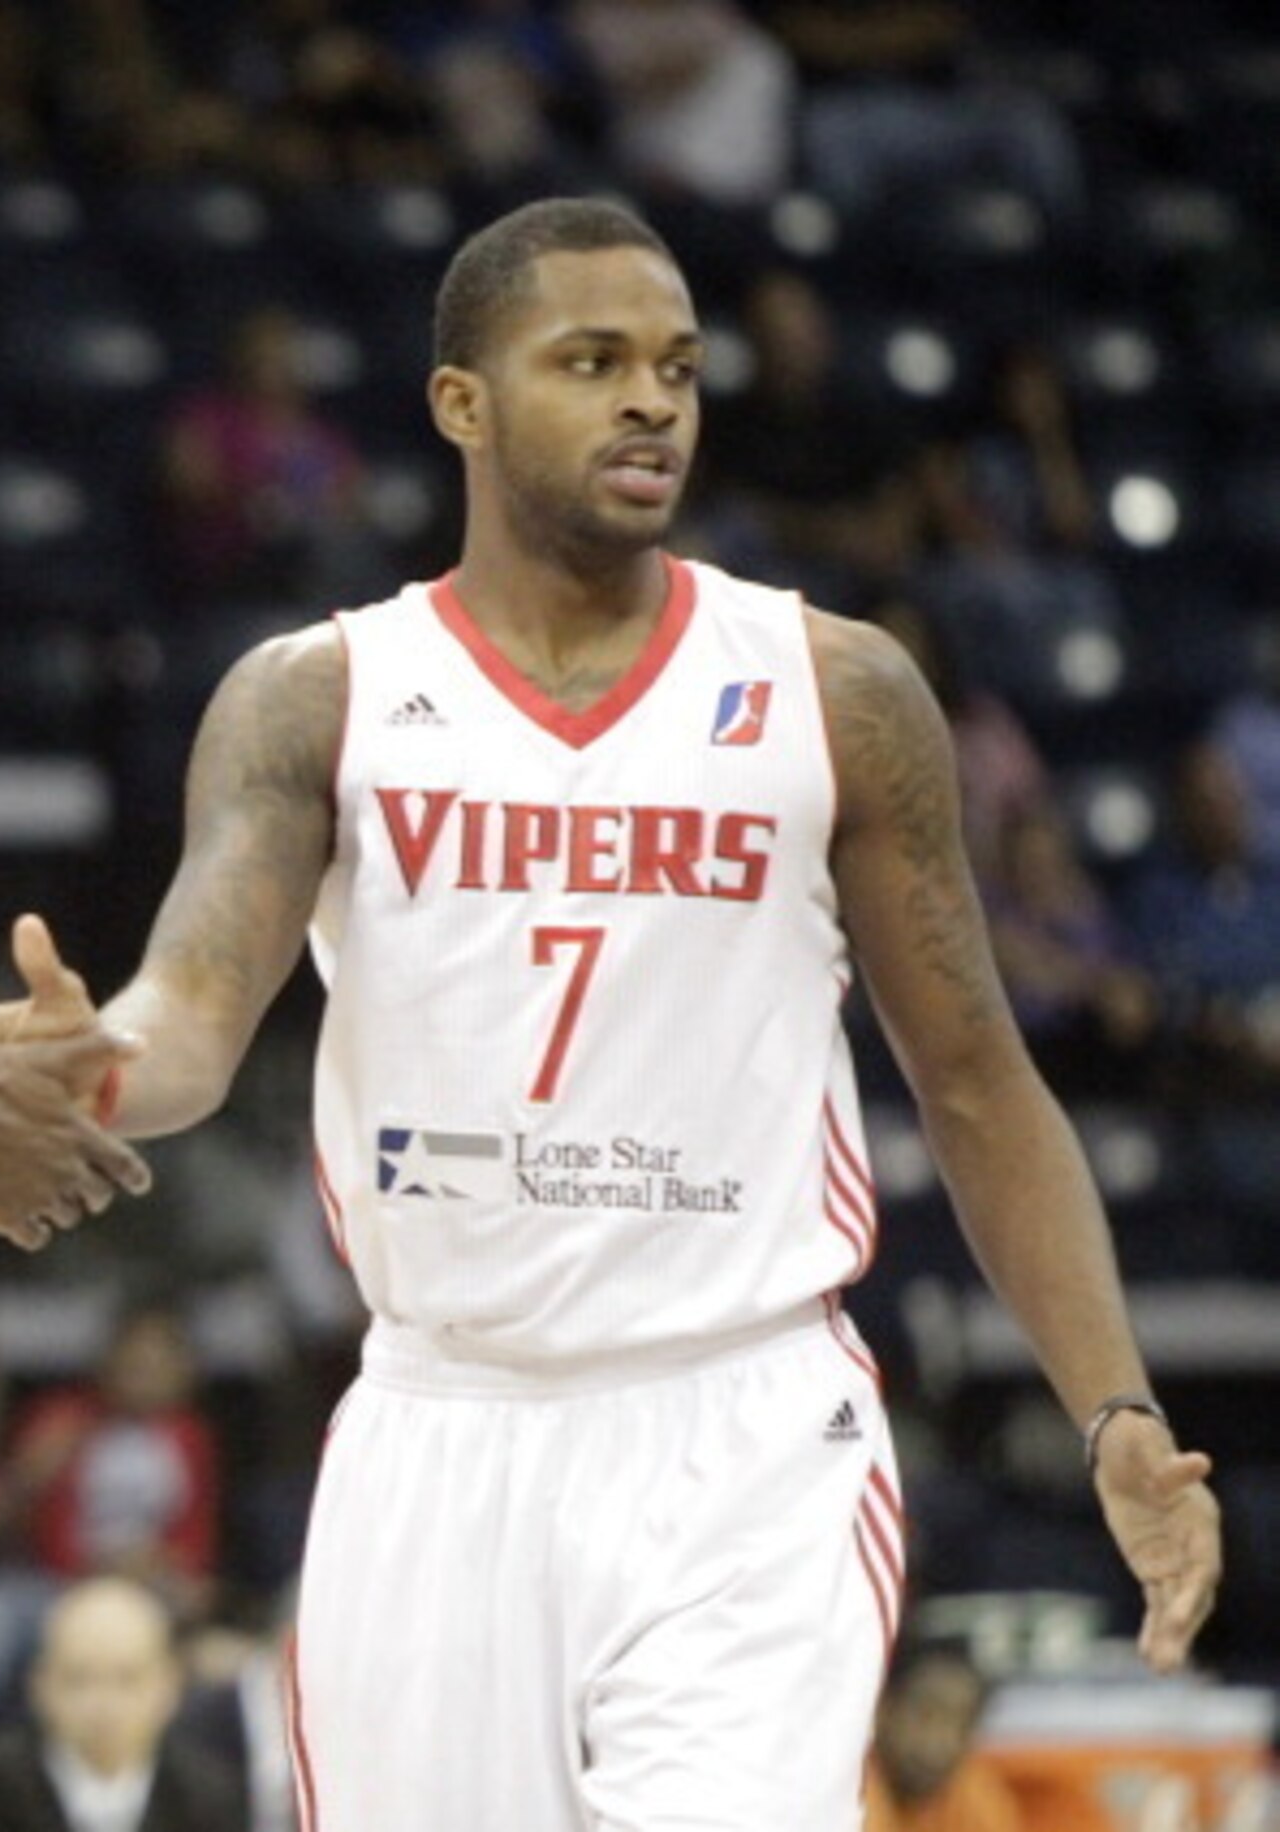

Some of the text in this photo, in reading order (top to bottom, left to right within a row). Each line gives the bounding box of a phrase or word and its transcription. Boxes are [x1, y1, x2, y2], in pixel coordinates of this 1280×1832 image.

[373, 787, 777, 903] VIPERS
[528, 925, 606, 1103] 7
[515, 1133, 681, 1173] Lone Star
[516, 1171, 742, 1213] National Bank
